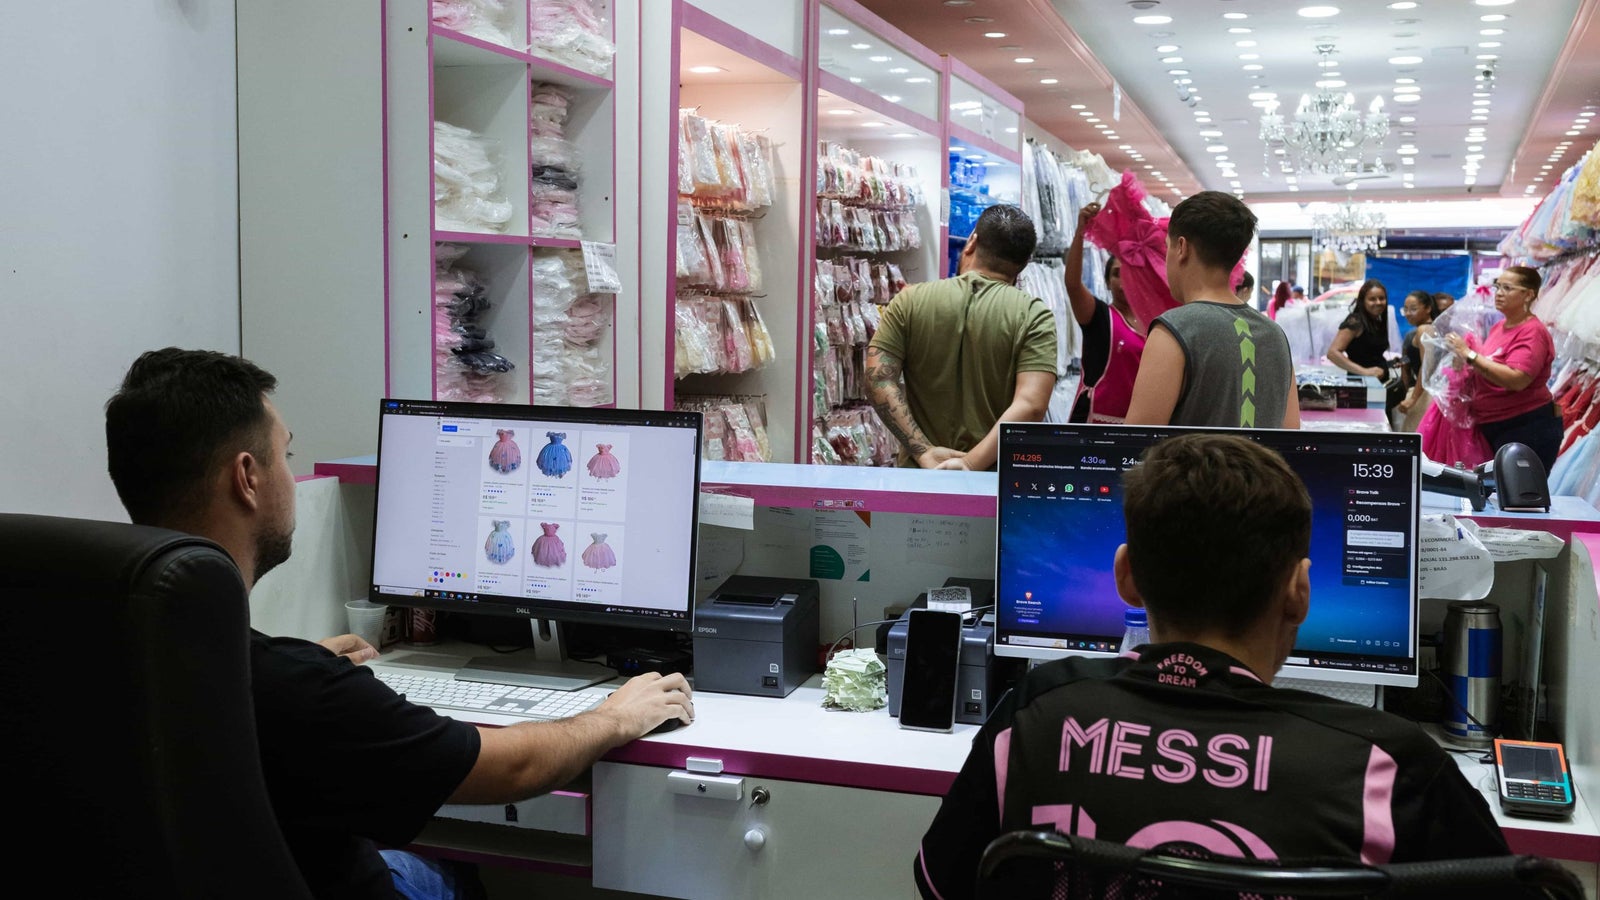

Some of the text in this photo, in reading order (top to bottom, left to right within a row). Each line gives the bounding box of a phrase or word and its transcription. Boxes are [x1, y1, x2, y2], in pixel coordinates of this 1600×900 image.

[1012, 453, 1042, 462] 174.295
[1080, 456, 1098, 464] 4.30
[1122, 457, 1134, 465] 2.4
[1352, 463, 1394, 478] 15:39
[1347, 514, 1371, 522] 0,000
[1157, 653, 1208, 676] FREEDOM
[1174, 665, 1186, 674] TO
[1158, 673, 1196, 688] DREAM
[1059, 716, 1273, 791] MESSI
